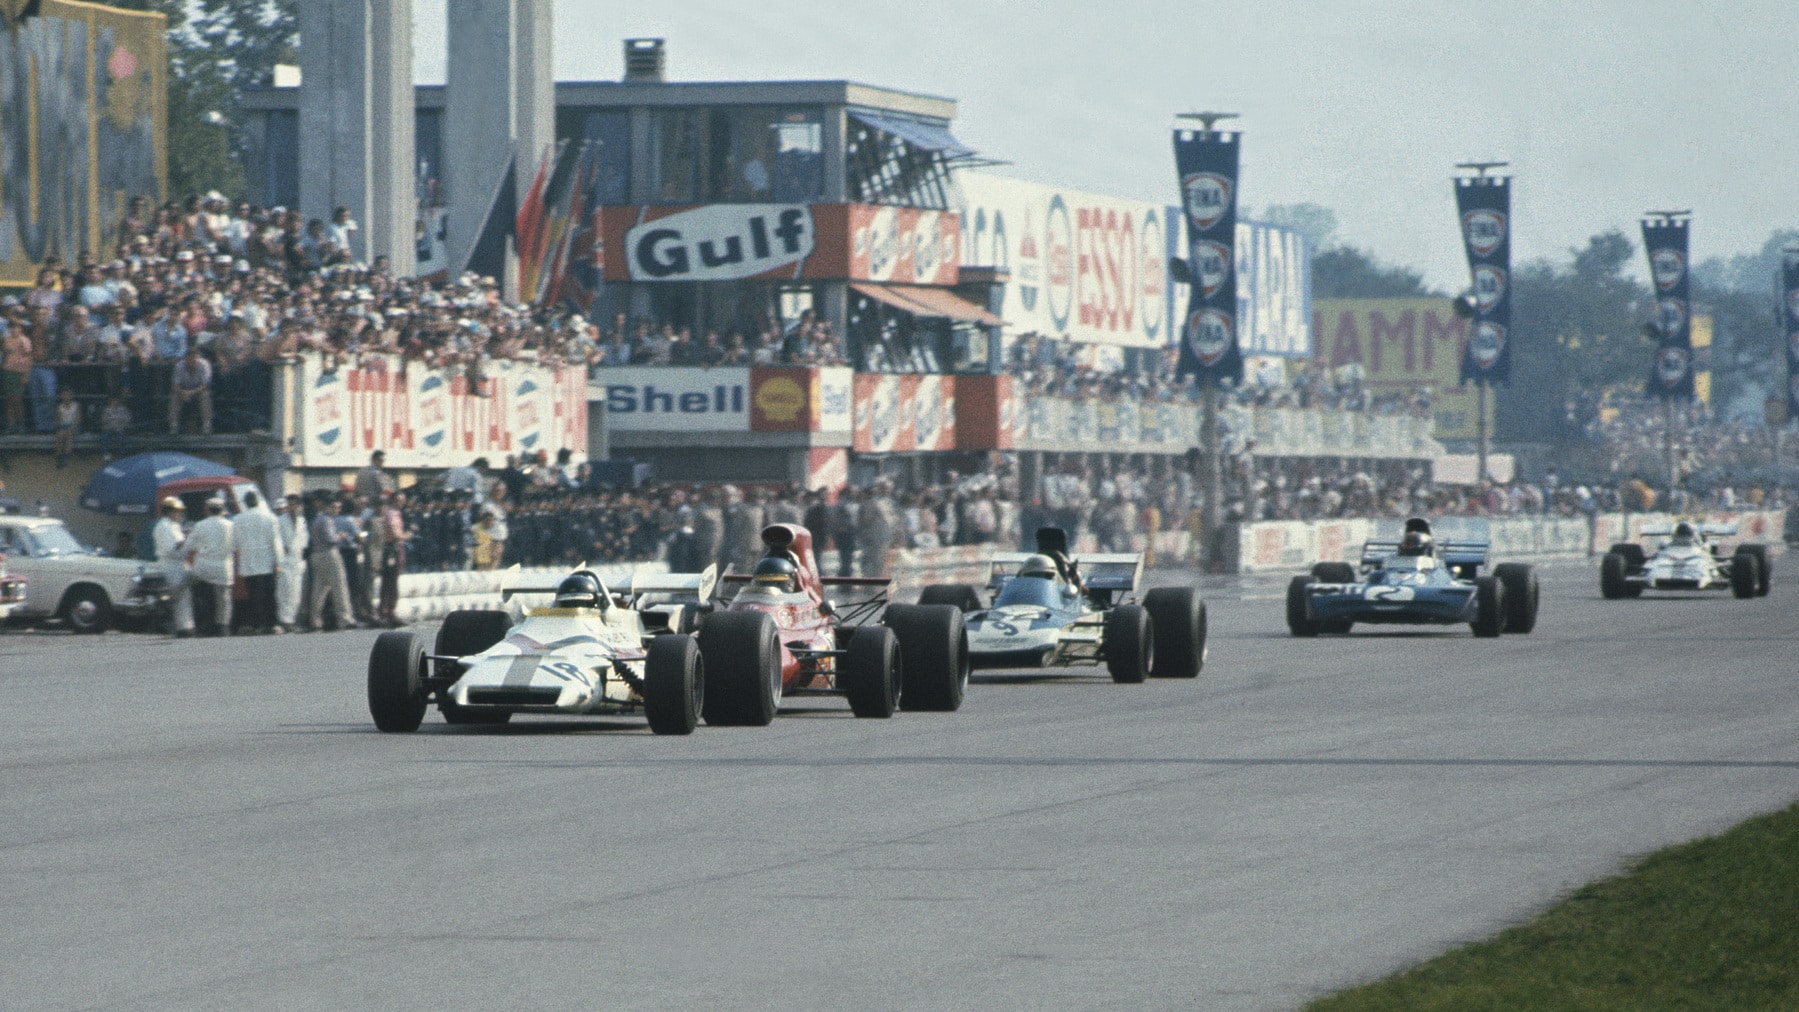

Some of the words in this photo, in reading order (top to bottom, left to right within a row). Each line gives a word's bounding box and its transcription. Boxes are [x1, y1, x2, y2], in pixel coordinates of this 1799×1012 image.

[636, 208, 805, 278] Gulf
[1077, 206, 1136, 332] ESSO
[1313, 310, 1466, 373] IAMM
[347, 368, 414, 450] TOTAL
[607, 384, 743, 413] Shell
[539, 662, 591, 687] 18
